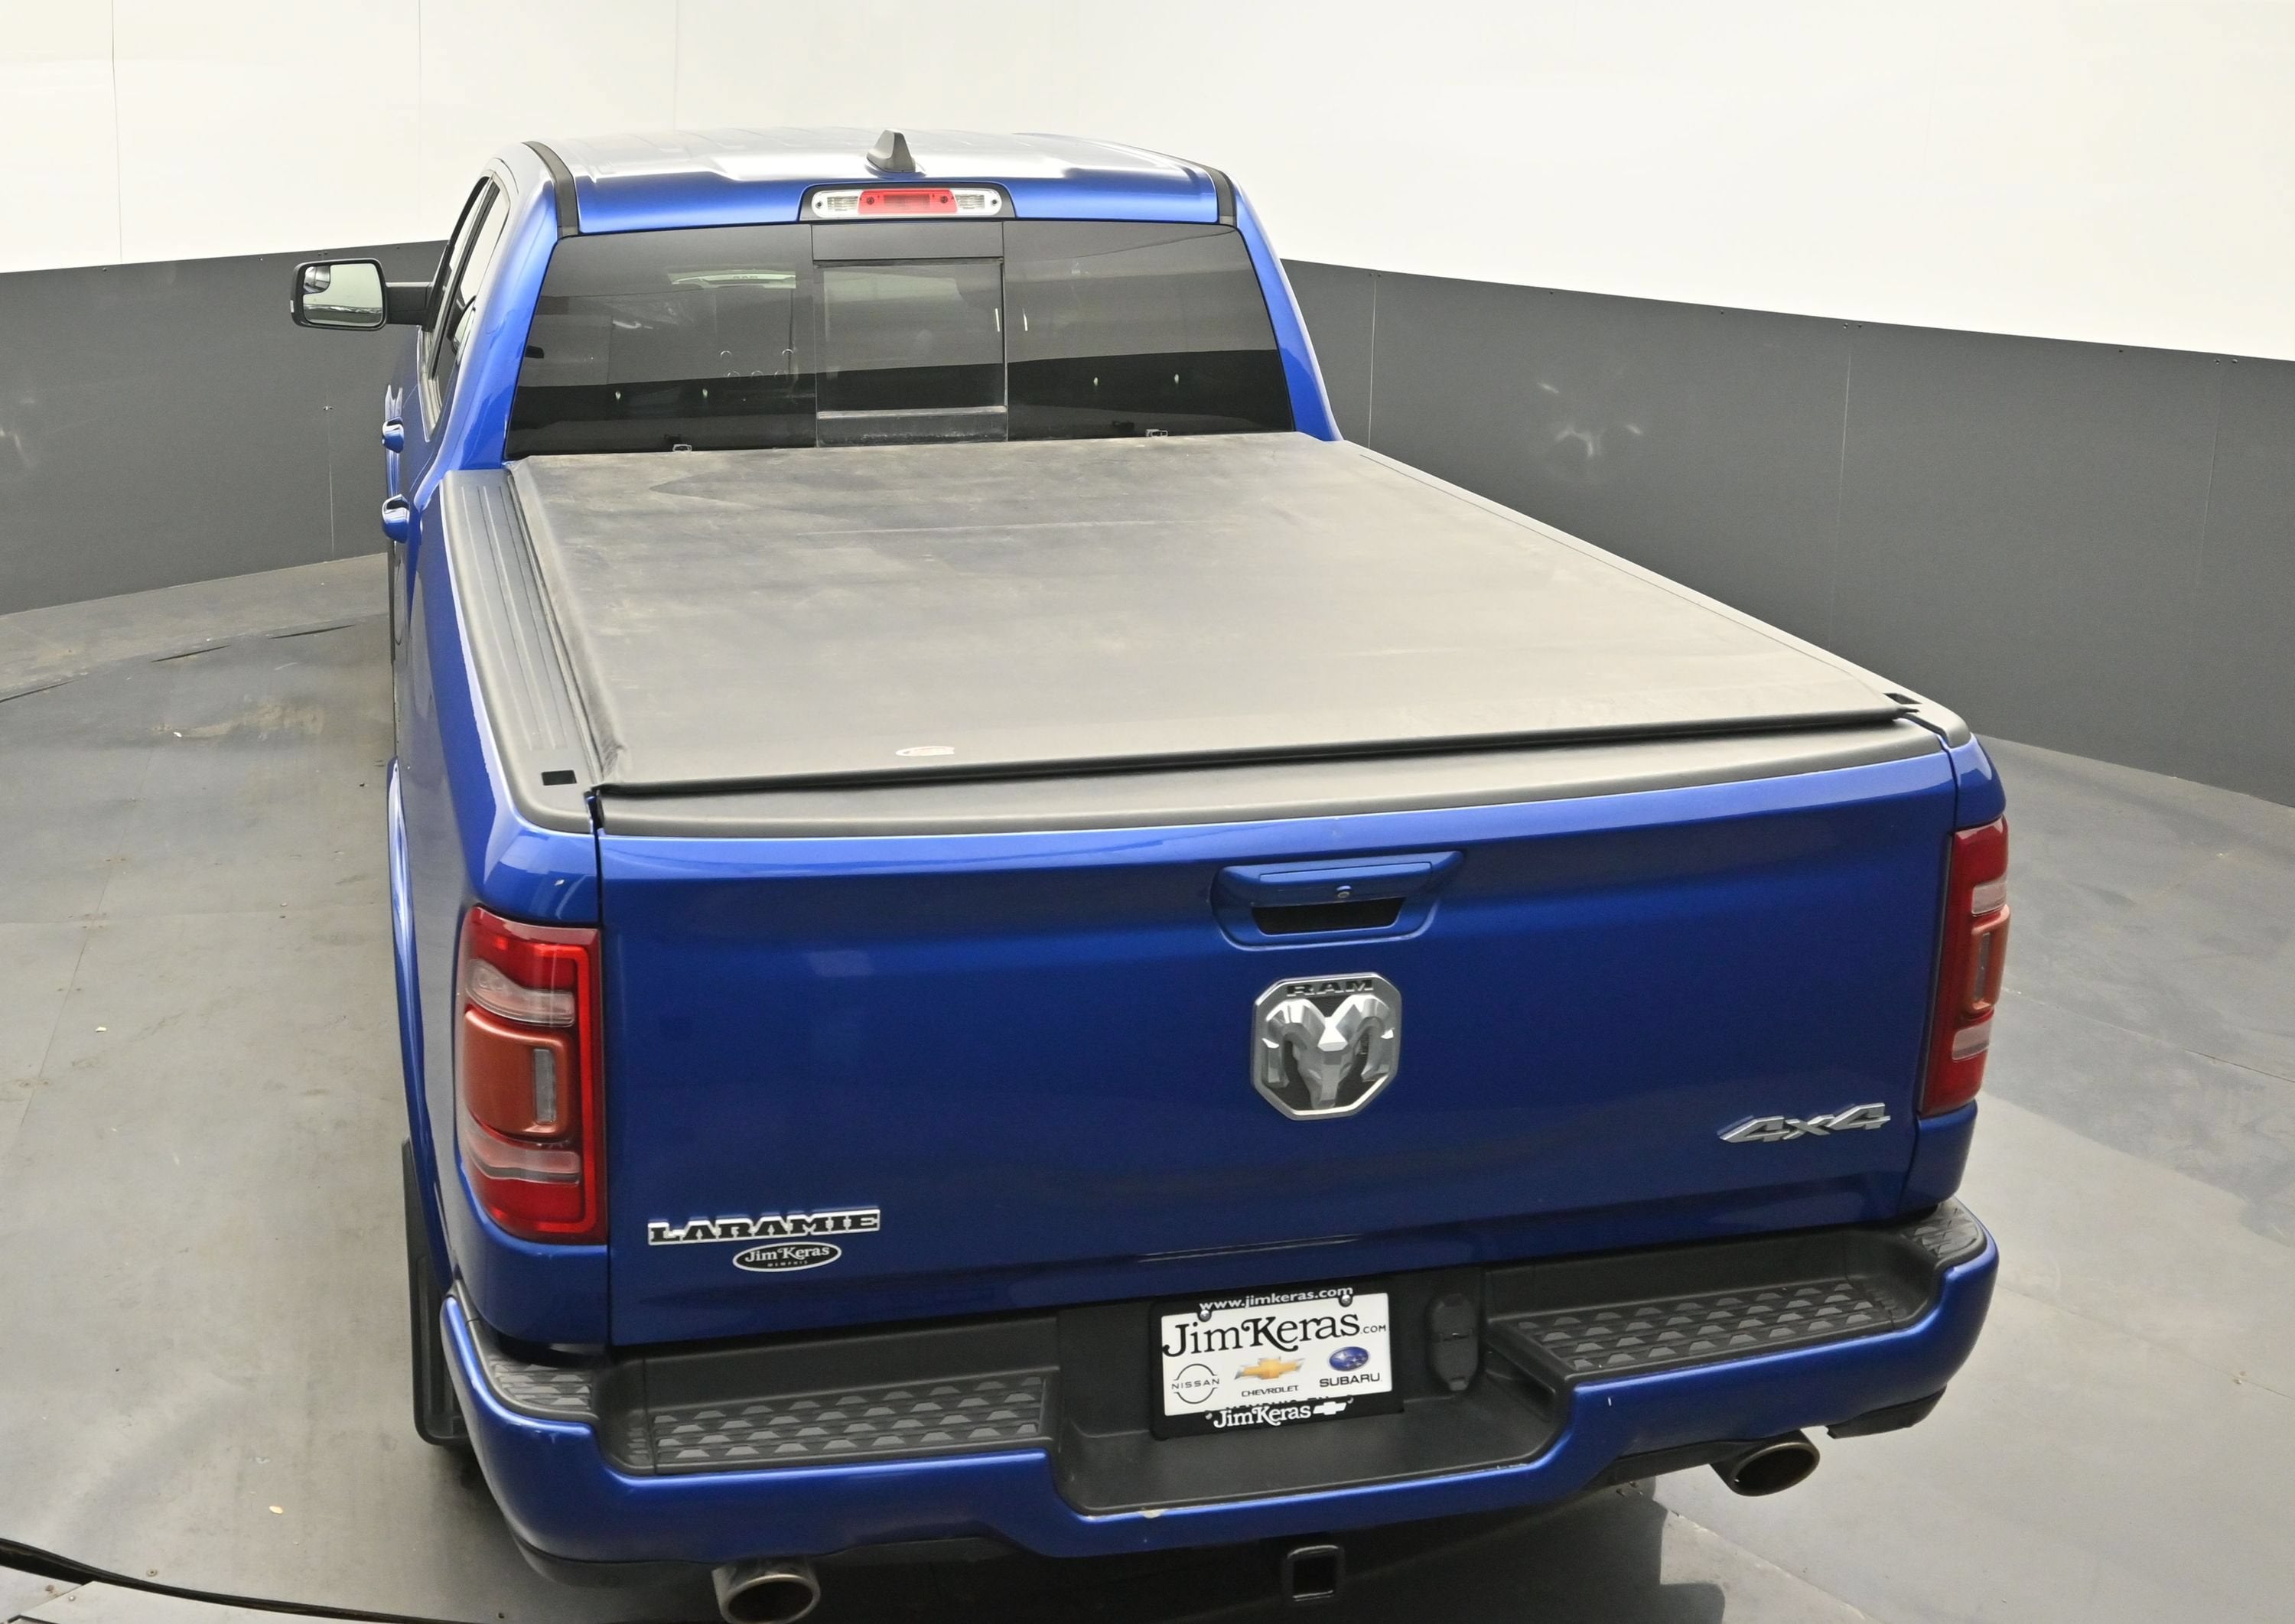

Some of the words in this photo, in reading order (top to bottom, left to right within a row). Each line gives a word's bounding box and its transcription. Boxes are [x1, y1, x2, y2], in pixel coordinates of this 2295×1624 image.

[1287, 979, 1374, 997] RAM
[648, 1209, 881, 1245] LARAMIE
[1199, 1287, 1353, 1310] www.jimkeras.com
[1171, 1378, 1220, 1390] NISSAN
[1320, 1373, 1381, 1388] SUBARU
[1241, 1385, 1299, 1397] CHEVROLET
